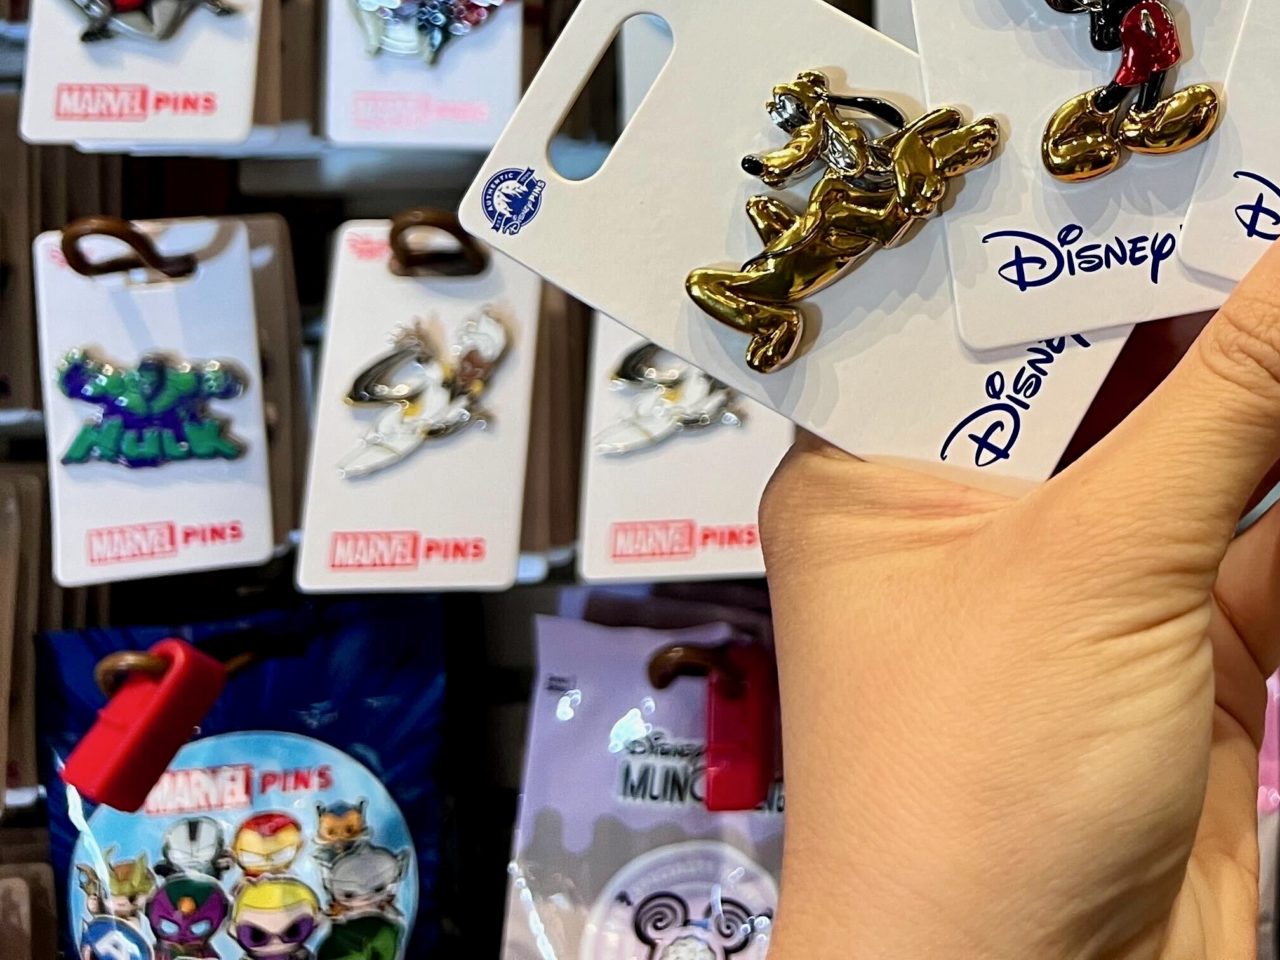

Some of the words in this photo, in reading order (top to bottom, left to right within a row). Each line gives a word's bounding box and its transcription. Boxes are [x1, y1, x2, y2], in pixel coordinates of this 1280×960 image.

[55, 84, 149, 122] MARVEL
[152, 93, 216, 116] PINS
[486, 173, 514, 212] AUTHENTIC
[528, 180, 546, 203] PINS
[982, 224, 1176, 292] Disney
[940, 333, 1091, 467] Disn
[61, 416, 244, 466] HULK
[87, 522, 178, 566] MARVEL
[180, 520, 243, 546] PINS
[328, 531, 421, 571] MARVEL
[422, 538, 486, 562] PINS
[611, 519, 698, 563] MARVEL
[699, 525, 759, 549] PINS
[143, 763, 252, 816] MARVEL
[260, 762, 334, 797] PINS
